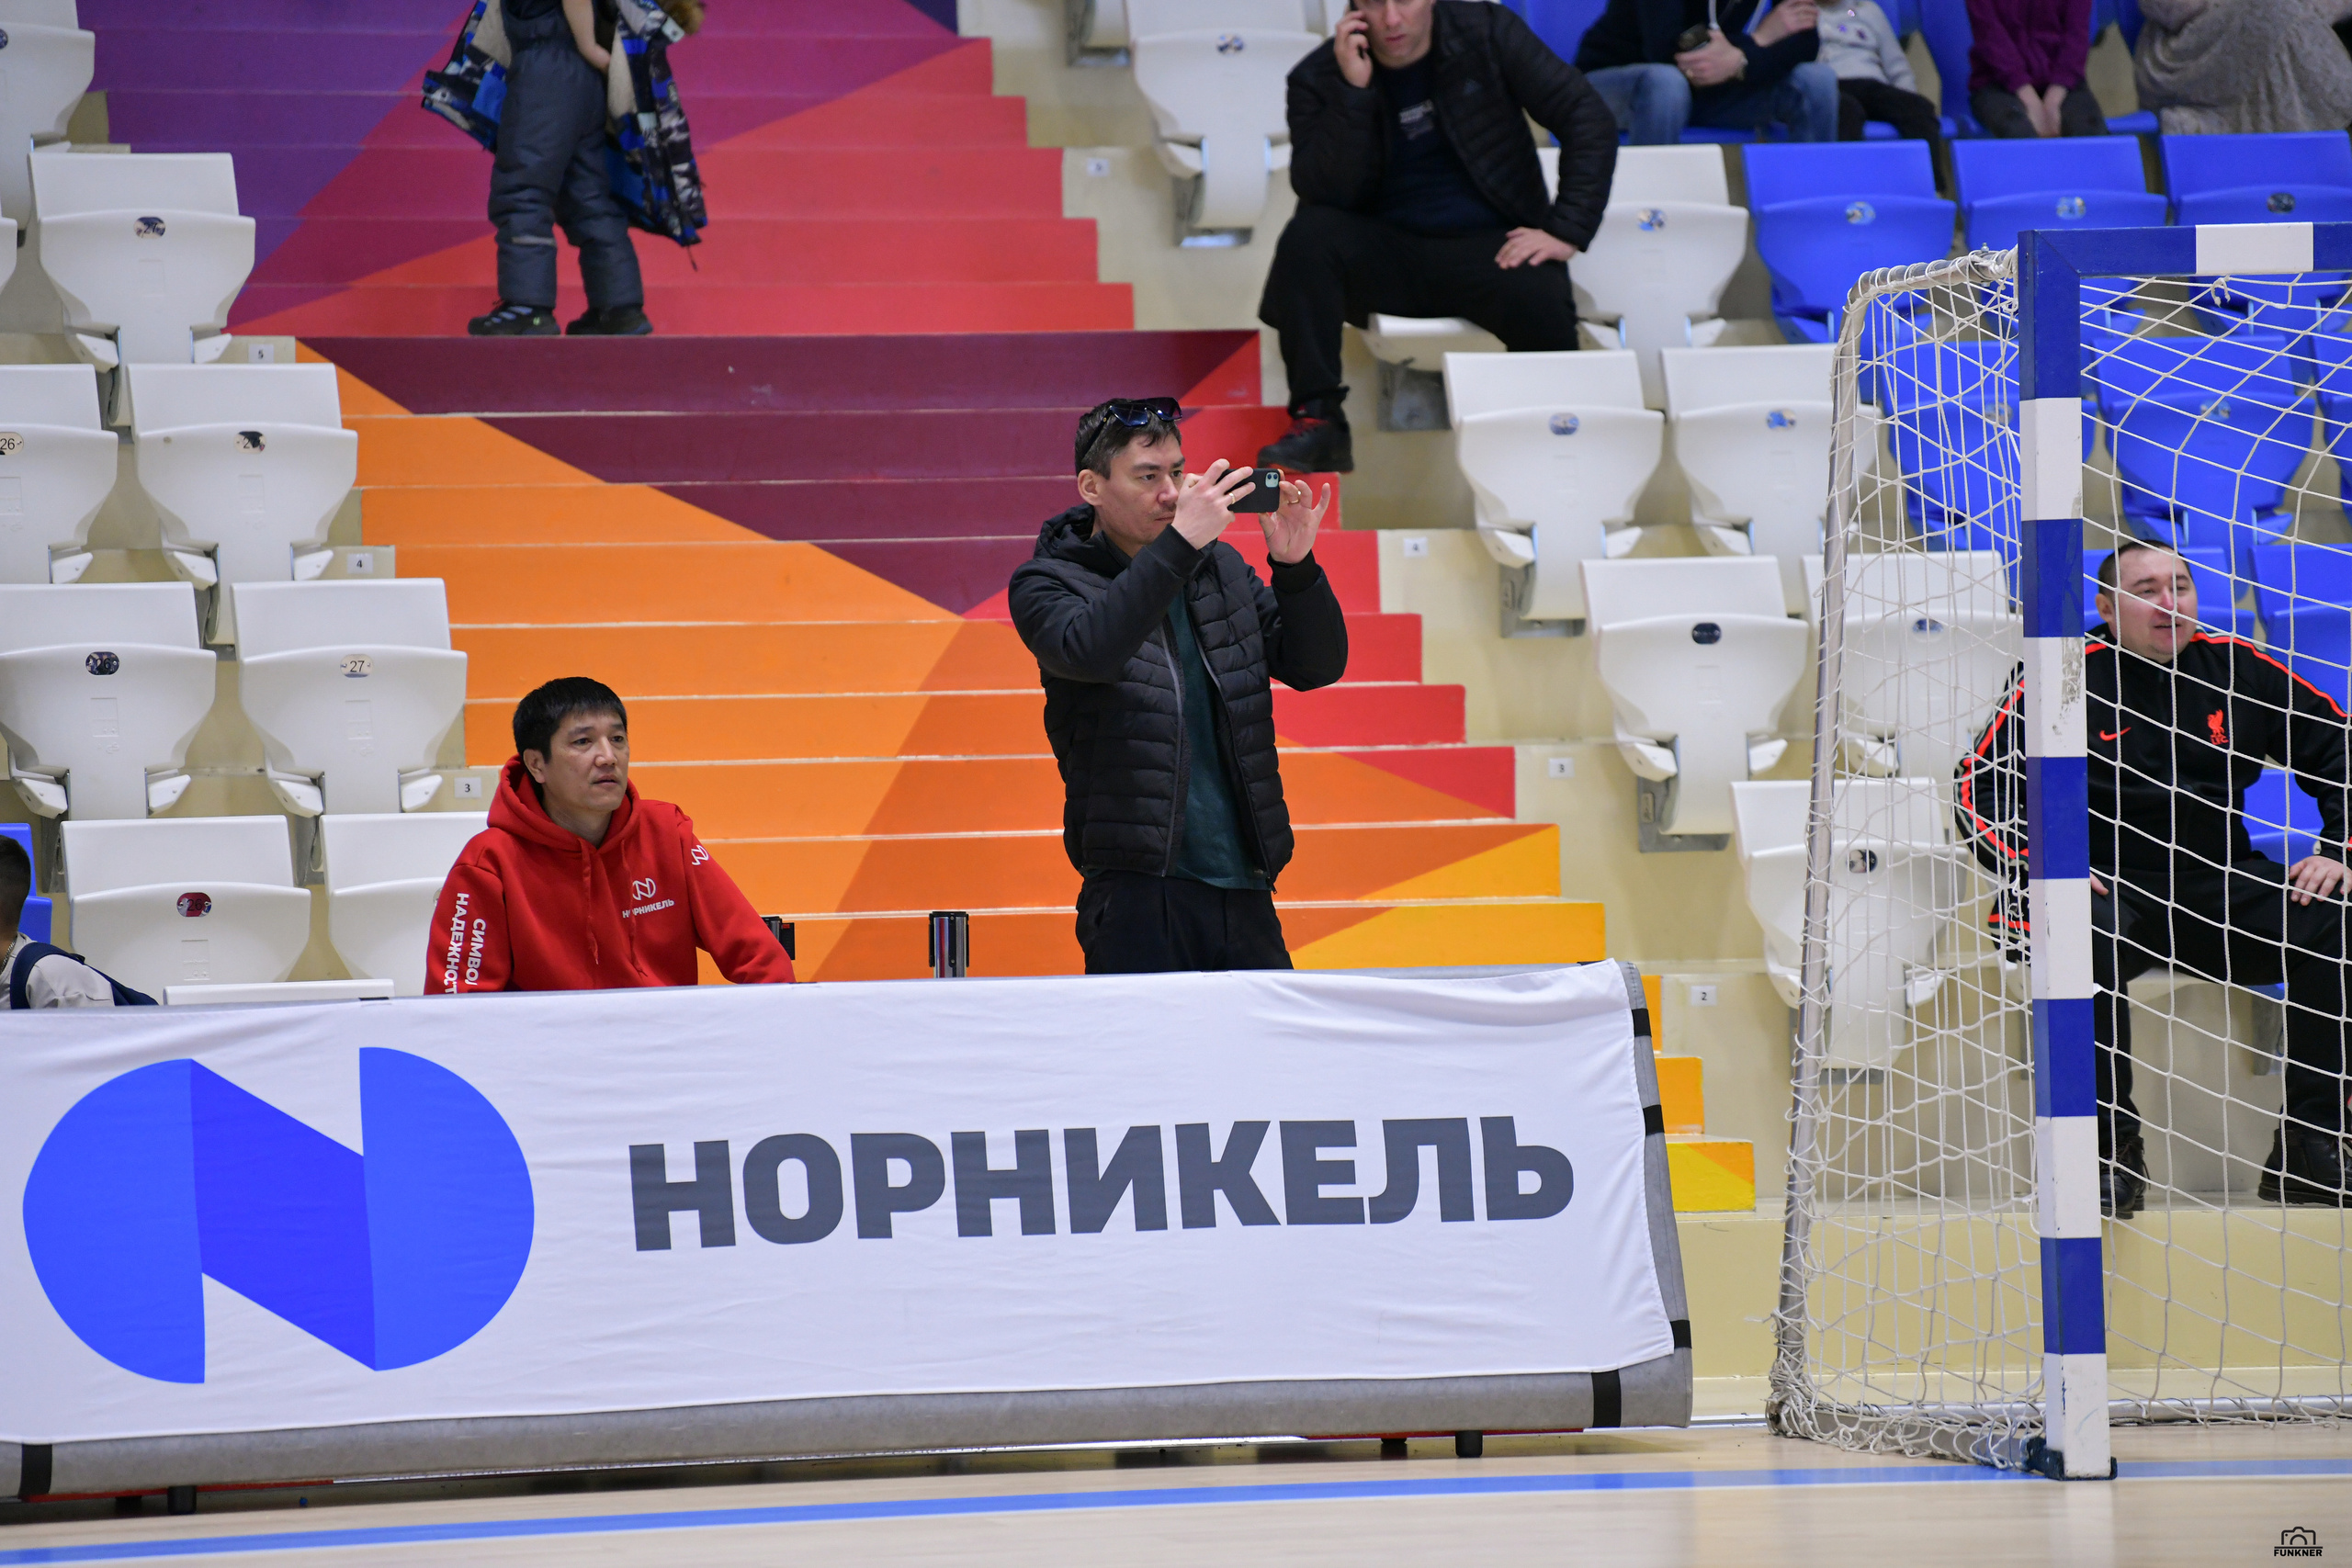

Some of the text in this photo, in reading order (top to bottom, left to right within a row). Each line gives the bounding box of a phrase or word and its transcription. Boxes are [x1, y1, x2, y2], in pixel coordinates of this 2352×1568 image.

[0, 438, 15, 450] 26
[356, 559, 363, 568] 4
[96, 658, 111, 670] 26
[350, 660, 365, 672] 27
[464, 784, 470, 793] 3
[187, 898, 202, 911] 26
[1702, 992, 1707, 1000] 2
[628, 1116, 1574, 1251] НОРНИКЕЛЬ
